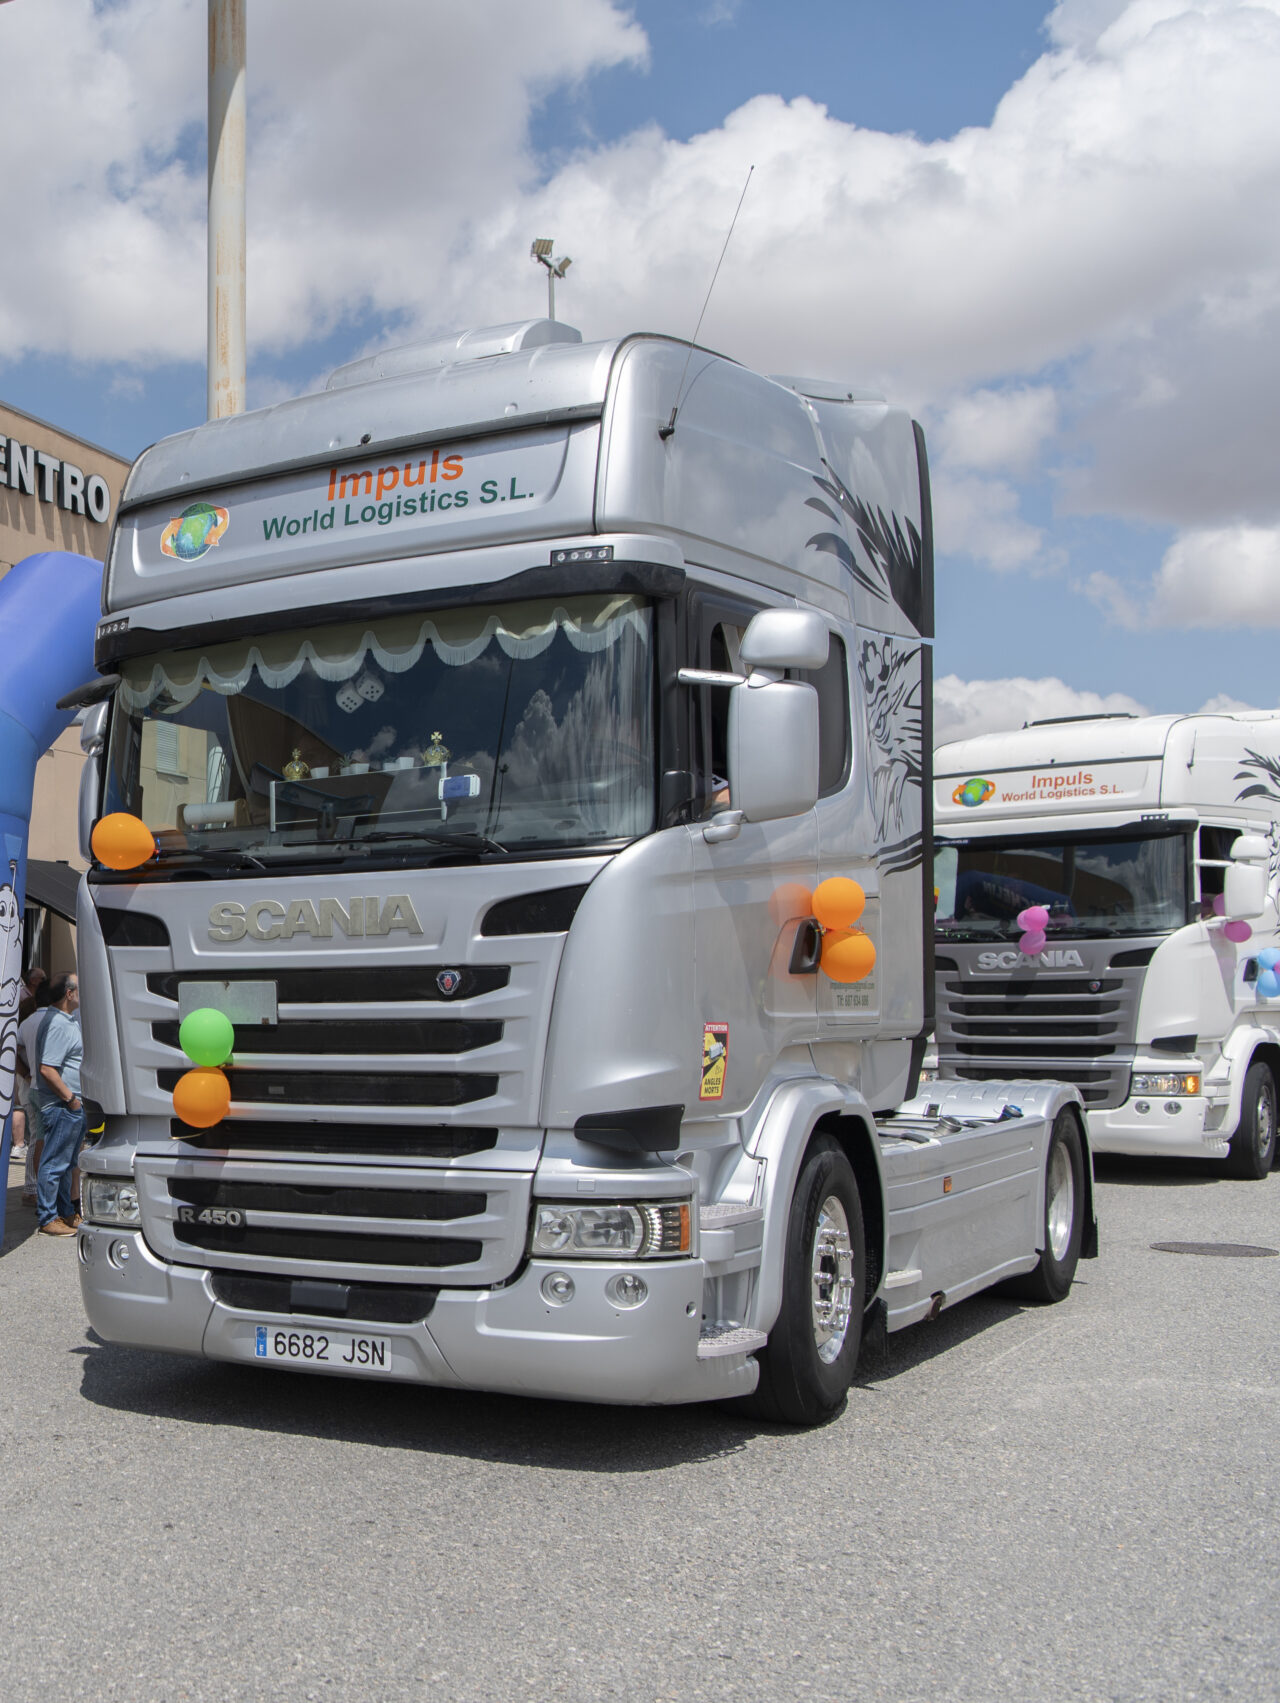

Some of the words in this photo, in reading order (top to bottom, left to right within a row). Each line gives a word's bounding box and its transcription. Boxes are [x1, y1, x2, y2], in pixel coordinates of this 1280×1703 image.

[327, 450, 464, 501] Impuls
[262, 505, 335, 541] World
[344, 487, 469, 527] Logistics
[479, 477, 535, 504] S.L.
[1032, 771, 1093, 790] Impuls
[1001, 790, 1036, 802] World
[1039, 786, 1096, 801] Logistics
[1099, 784, 1124, 795] S.L.
[208, 894, 424, 942] SCANIA
[977, 949, 1084, 970] SCANIA
[704, 1078, 721, 1086] ANGLES
[180, 1207, 196, 1223] R
[198, 1209, 242, 1226] 450
[274, 1332, 329, 1361] 6682
[342, 1338, 385, 1366] JSN
